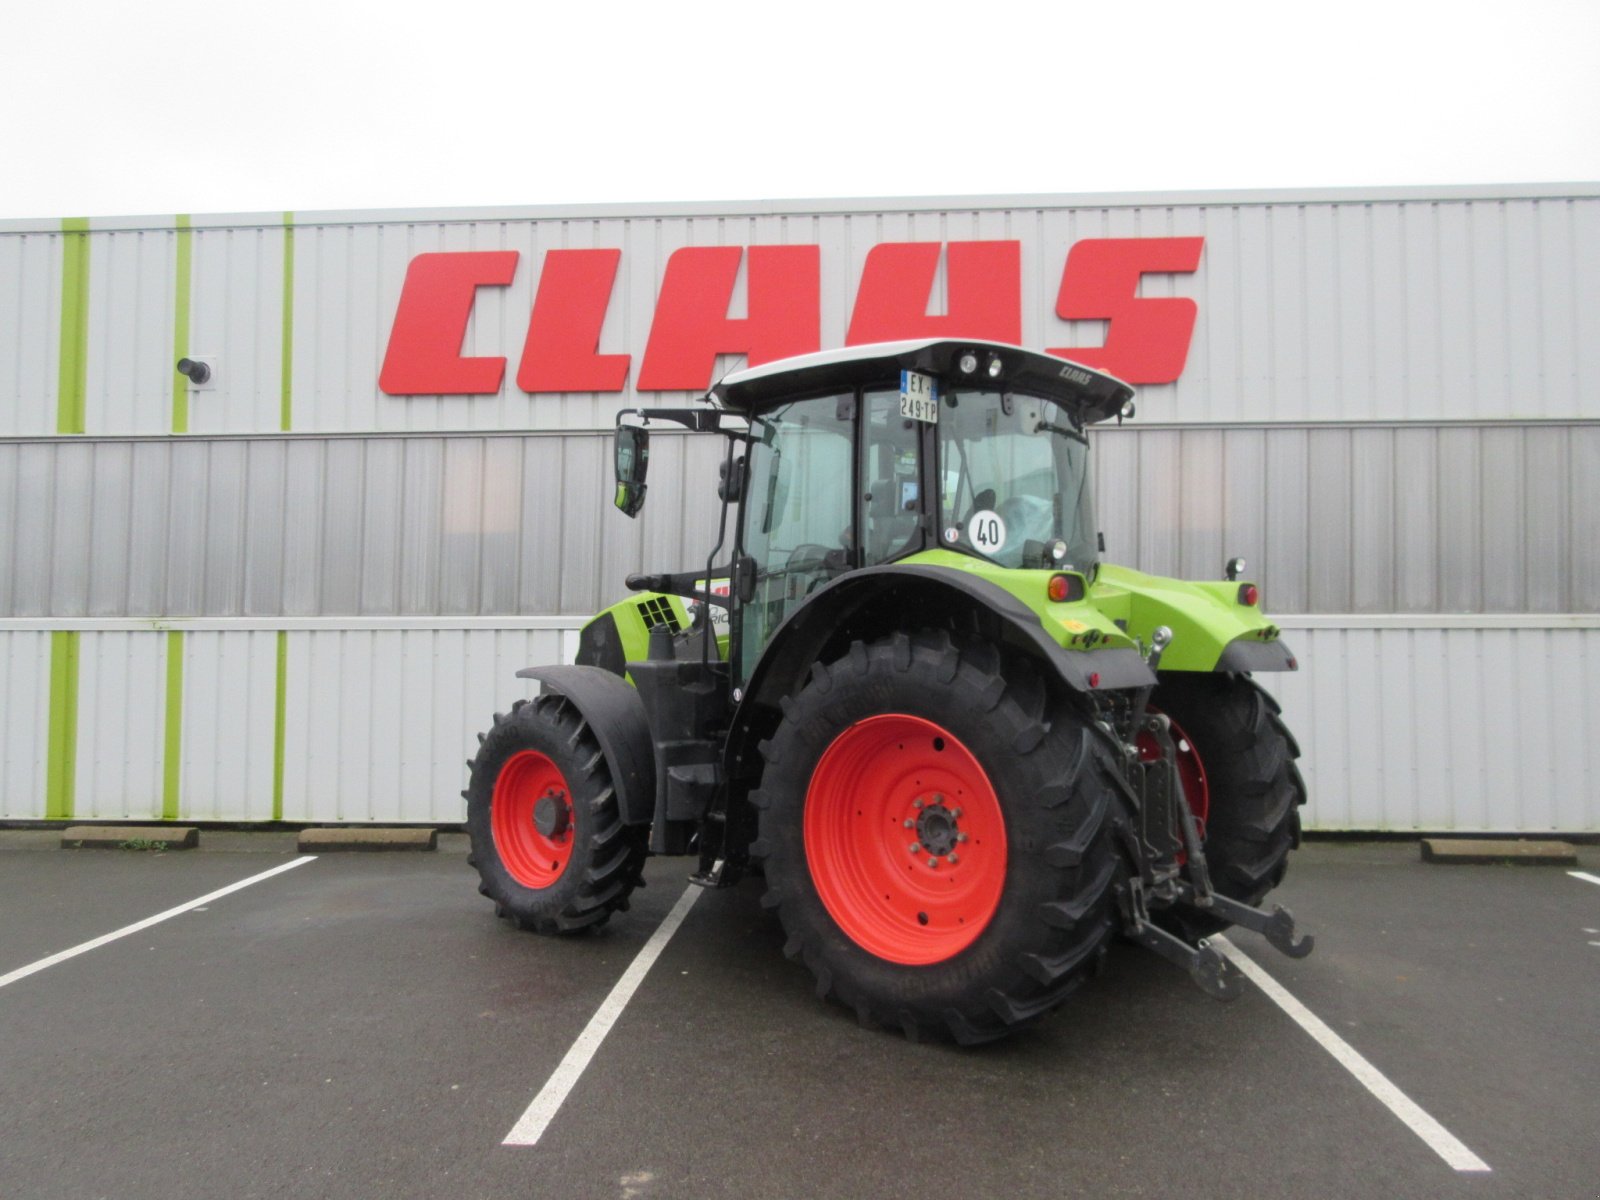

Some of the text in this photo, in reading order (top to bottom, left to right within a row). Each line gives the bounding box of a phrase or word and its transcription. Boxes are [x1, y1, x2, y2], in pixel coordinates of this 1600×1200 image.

[378, 236, 1205, 395] CLAAS
[1059, 366, 1092, 385] CLAAS
[901, 397, 936, 421] 249-TP
[977, 519, 999, 545] 40
